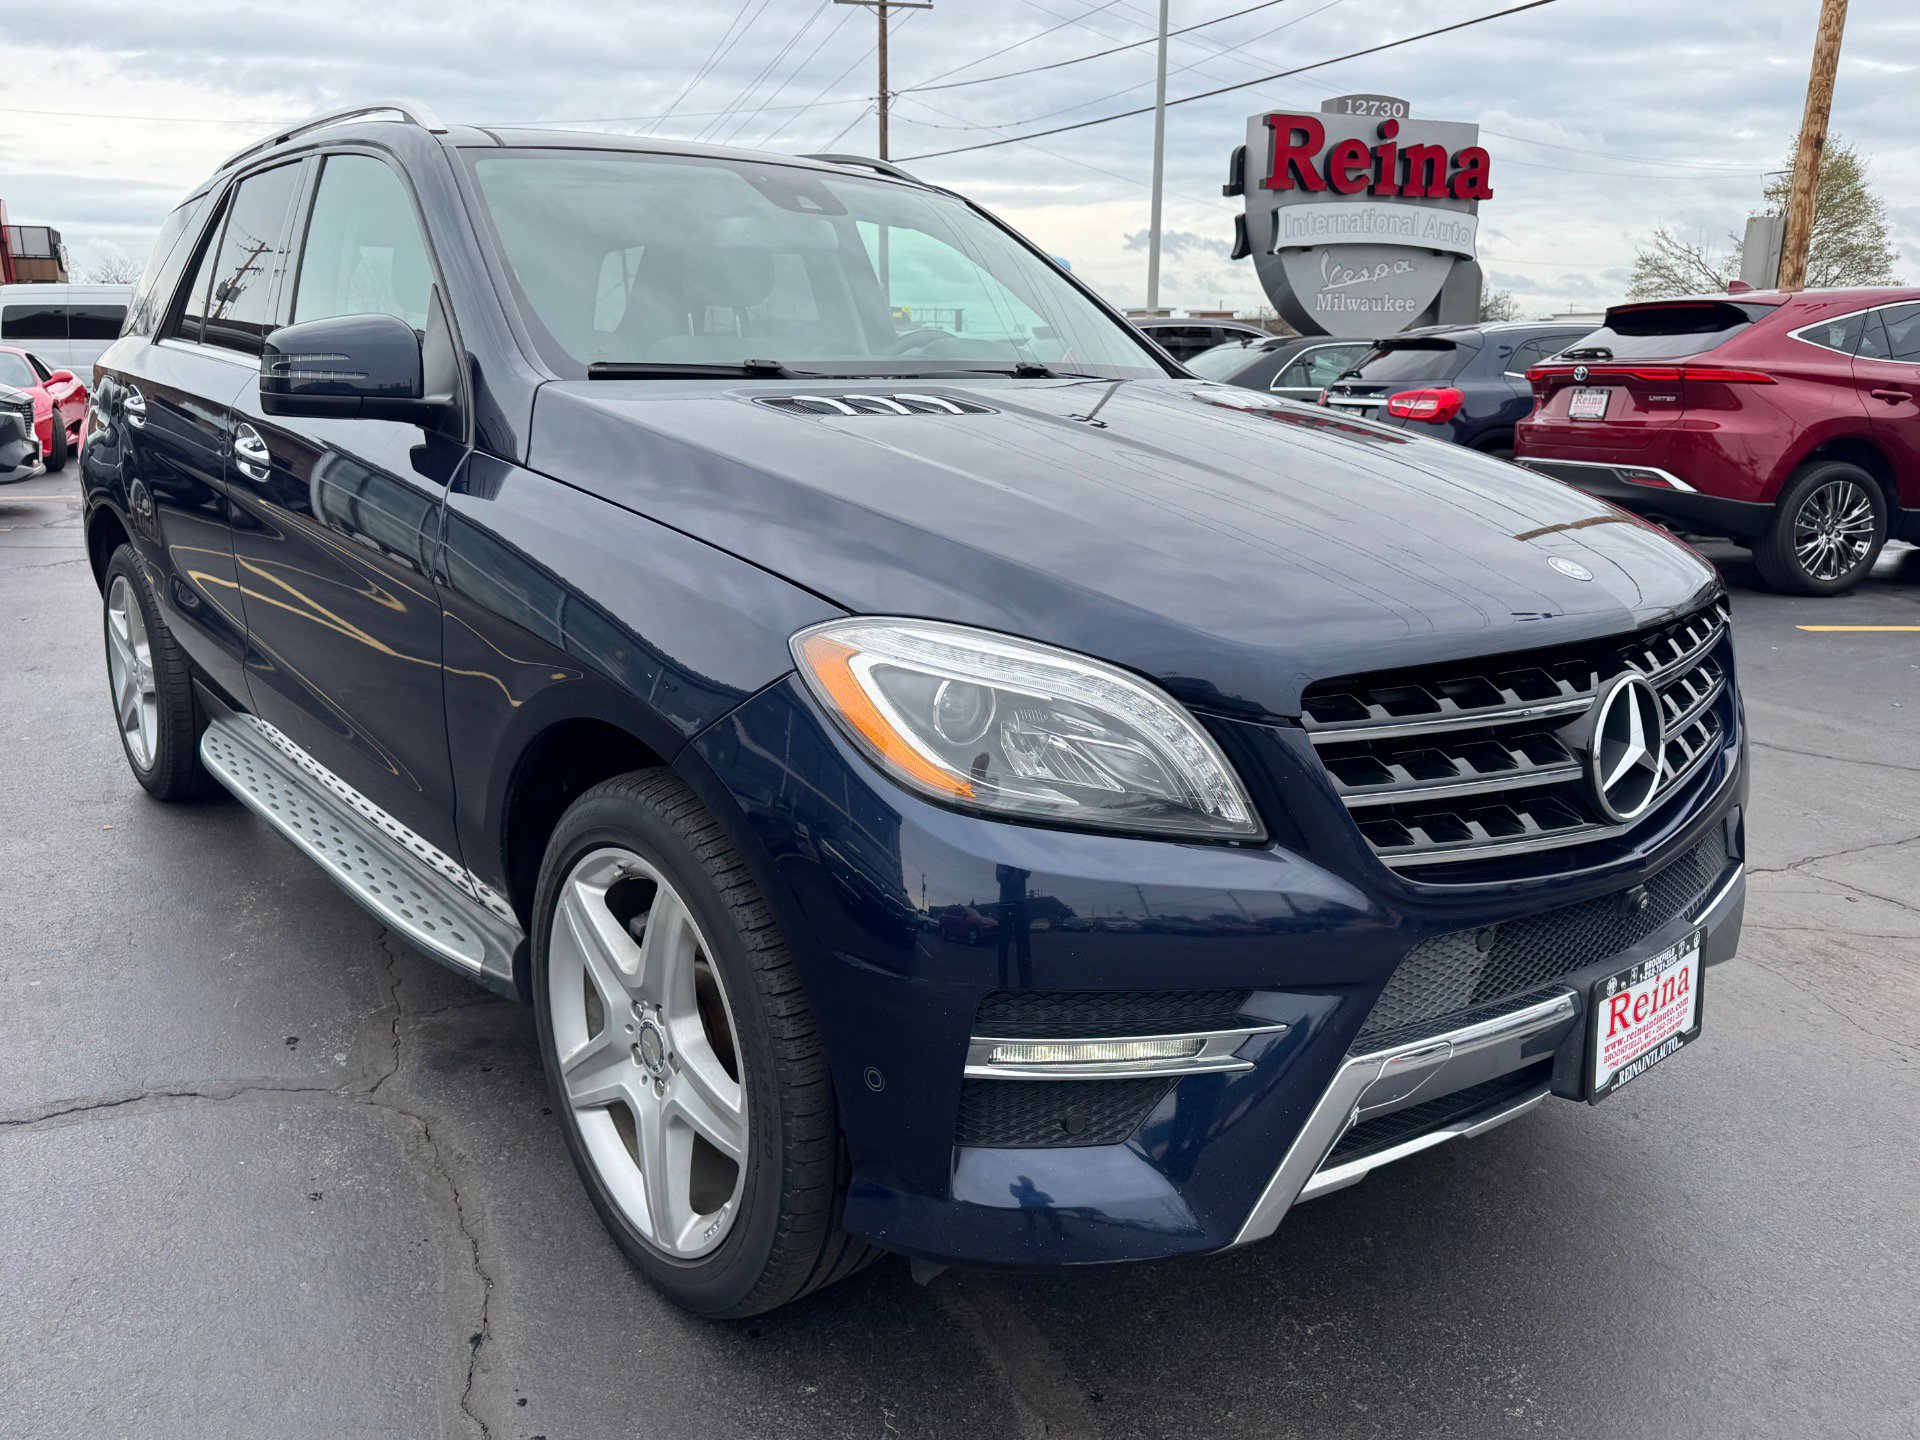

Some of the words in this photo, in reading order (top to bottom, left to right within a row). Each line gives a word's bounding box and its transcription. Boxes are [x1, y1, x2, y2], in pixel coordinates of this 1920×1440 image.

[1345, 99, 1405, 118] 12730
[1263, 113, 1493, 201] Reina
[1284, 208, 1419, 239] International
[1422, 214, 1472, 247] Auto
[1320, 249, 1416, 291] Vespa
[1315, 292, 1416, 313] Milwaukee
[1575, 394, 1604, 405] Reina
[1605, 966, 1690, 1039] Reina
